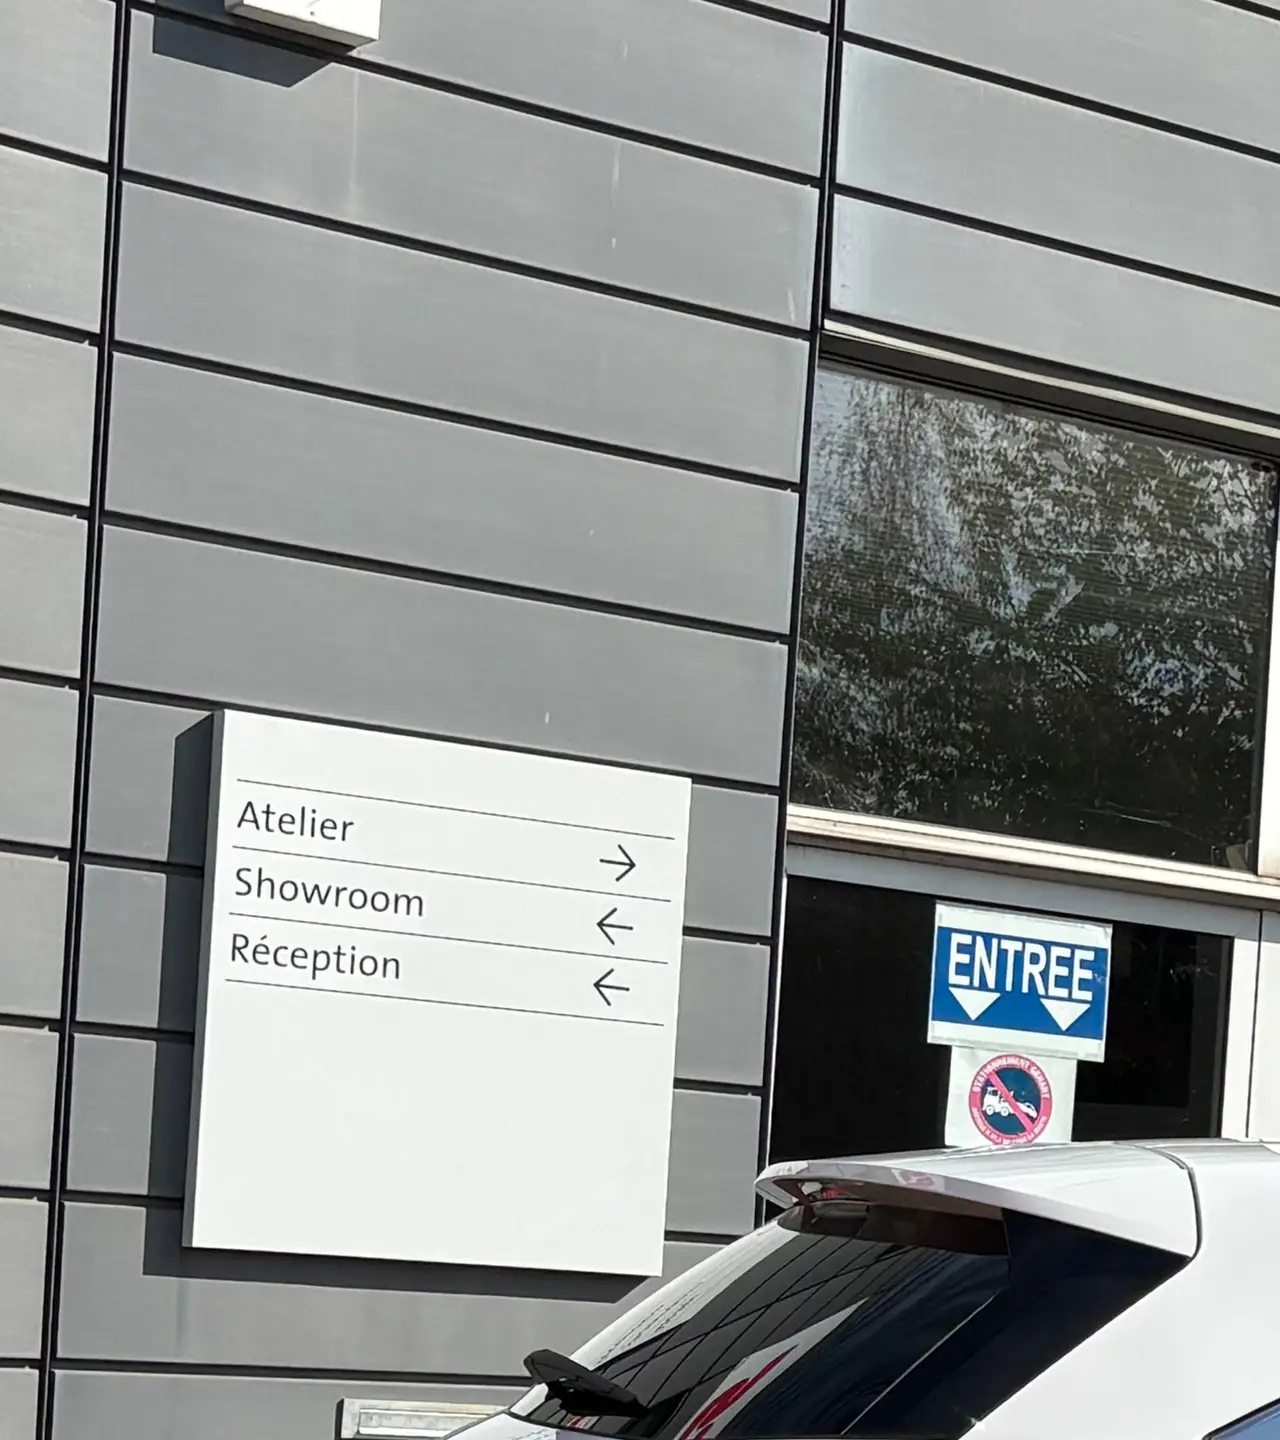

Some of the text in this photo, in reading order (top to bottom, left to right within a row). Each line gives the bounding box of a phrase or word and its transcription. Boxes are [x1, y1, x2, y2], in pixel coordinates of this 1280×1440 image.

[236, 800, 355, 842] Atelier
[234, 867, 425, 917] Showroom
[230, 932, 401, 981] Réception
[948, 931, 1096, 1001] ENTREE
